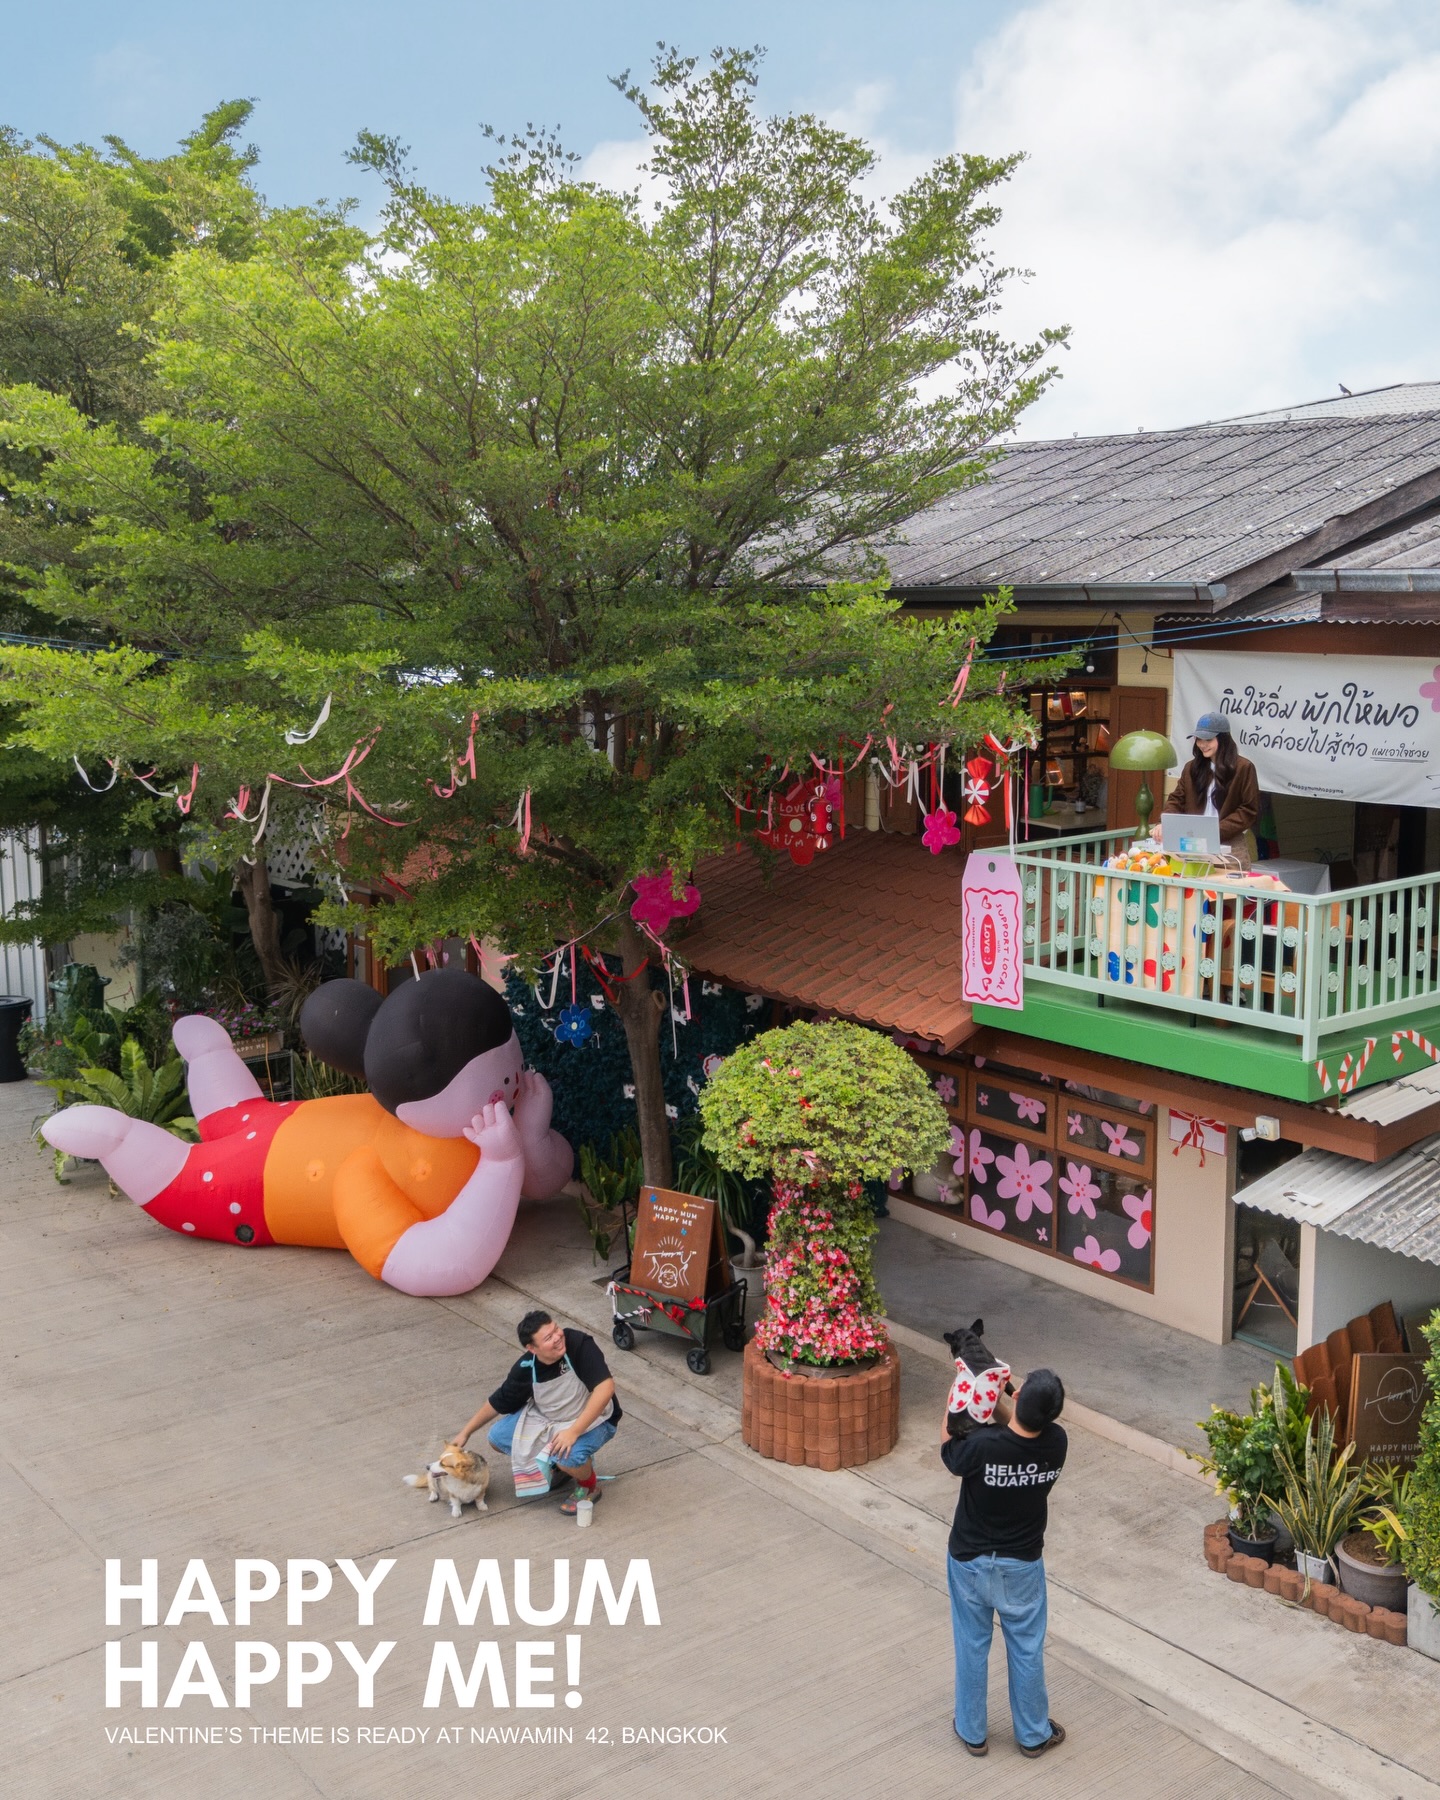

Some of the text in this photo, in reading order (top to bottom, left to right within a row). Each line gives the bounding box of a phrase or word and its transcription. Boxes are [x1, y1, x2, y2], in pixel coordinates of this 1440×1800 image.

[1219, 682, 1419, 728] กินให้อิ่ม พักให้พอ
[1239, 726, 1368, 762] แล้วค่อยไปสู้ต่อ
[983, 923, 992, 954] Love
[996, 903, 1010, 990] SUPPORT LOCAL
[653, 1205, 697, 1219] HAPPY MUM
[655, 1213, 679, 1223] HAPPY
[1370, 1443, 1398, 1453] HAPPY
[1372, 1454, 1401, 1464] HAPPY
[984, 1467, 1062, 1487] QUARTERS
[985, 1463, 1038, 1476] HELLO
